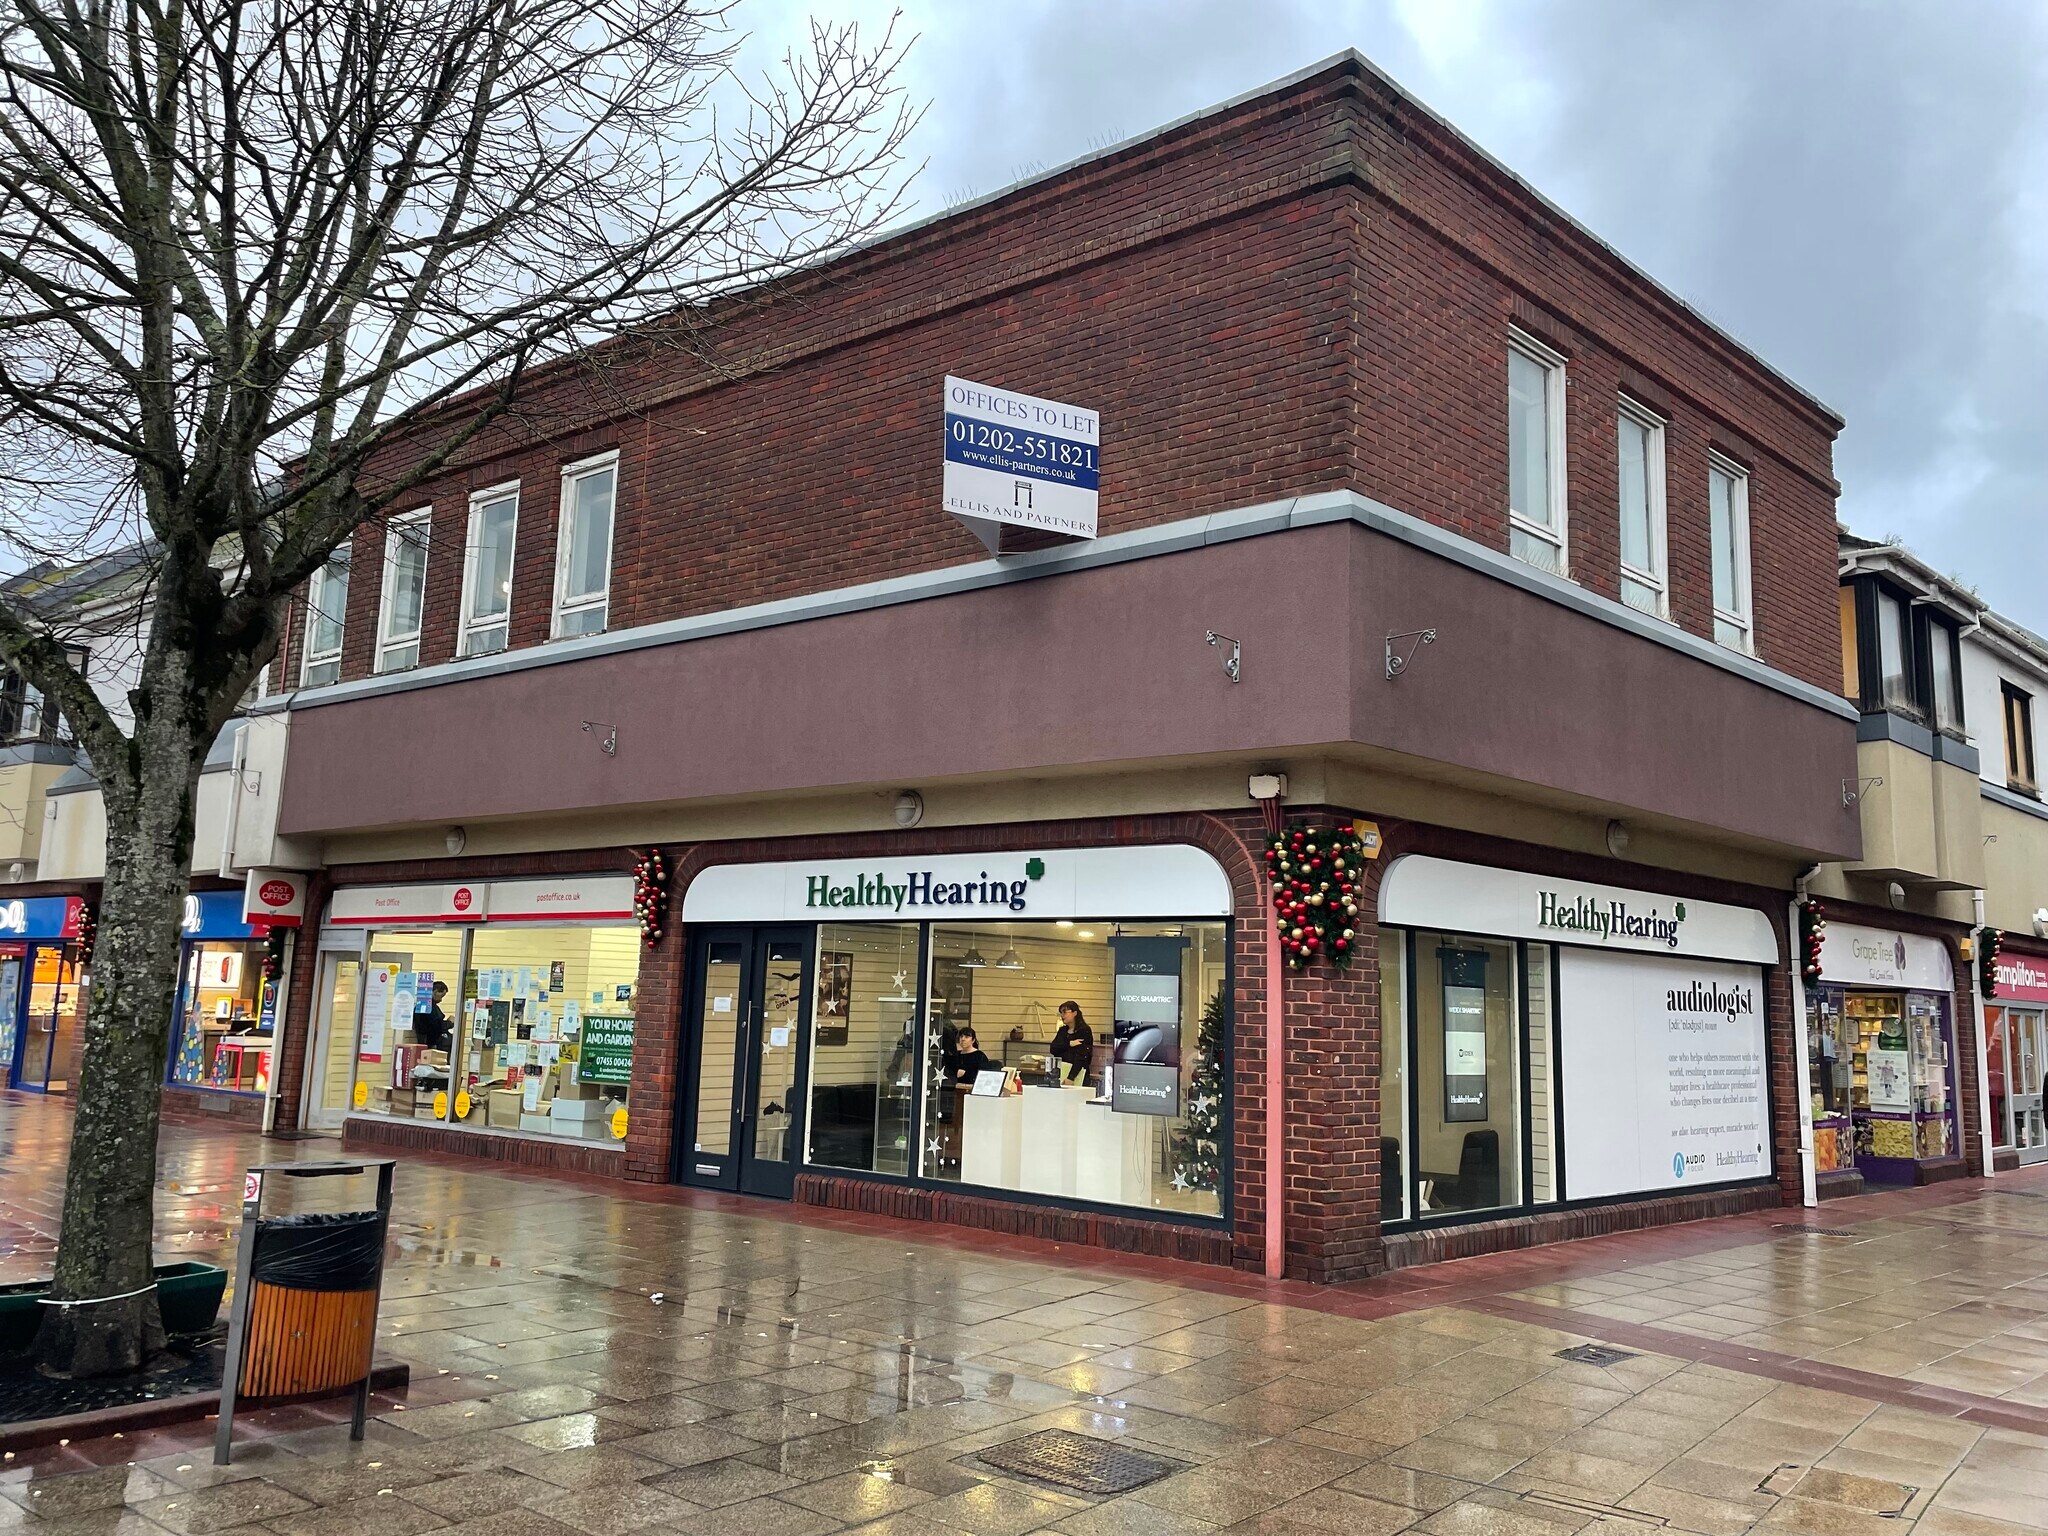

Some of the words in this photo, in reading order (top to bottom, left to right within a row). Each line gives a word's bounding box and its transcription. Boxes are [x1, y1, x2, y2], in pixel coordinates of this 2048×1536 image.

[952, 387, 1028, 419] OFFICES
[1033, 406, 1057, 425] TO
[1062, 413, 1095, 434] LET
[953, 420, 1093, 469] 01202-551821
[962, 450, 1076, 481] www.ellis-partners.co.uk
[951, 498, 989, 513] ELLIS
[993, 507, 1022, 519] AND
[1027, 513, 1094, 533] PARTNERS
[262, 892, 291, 901] OFFICE
[536, 892, 581, 903] postoffice.co.uk
[805, 871, 1028, 912] HealthyHearing
[375, 898, 386, 906] Post
[386, 898, 400, 906] Office
[1537, 890, 1679, 948] HealthyHearing
[1852, 938, 1878, 965] Grape
[1877, 941, 1894, 962] Tree
[418, 972, 434, 981] FREE
[1997, 960, 2036, 992] amplifon
[1666, 980, 1755, 1024] audiologist
[589, 1018, 611, 1030] YOUR
[611, 1019, 635, 1031] HOME
[586, 1032, 604, 1045] AND
[604, 1033, 634, 1046] GARDEN
[596, 1056, 613, 1066] 07455
[1668, 1054, 1678, 1062] one
[1679, 1052, 1689, 1062] who
[1690, 1052, 1703, 1064] helps
[1704, 1052, 1718, 1062] others
[1719, 1053, 1742, 1062] reconnect
[1742, 1052, 1751, 1061] with
[1686, 1066, 1706, 1078] resulting
[1707, 1067, 1712, 1076] in
[1725, 1066, 1751, 1077] meaningful
[1752, 1066, 1760, 1075] and
[1119, 1084, 1167, 1099] HealthyHearing
[1669, 1081, 1689, 1095] happier
[1706, 1081, 1730, 1090] healthcare
[1731, 1079, 1757, 1092] professional
[1670, 1097, 1681, 1106] who
[1682, 1096, 1701, 1108] changes
[1702, 1095, 1712, 1105] lives
[1722, 1094, 1738, 1104] decibel
[1690, 1125, 1709, 1137] hearing
[1726, 1122, 1743, 1132] miracle
[1744, 1121, 1759, 1131] worker
[1686, 1154, 1706, 1165] AUDIO
[1716, 1150, 1759, 1167] HealthyHearing
